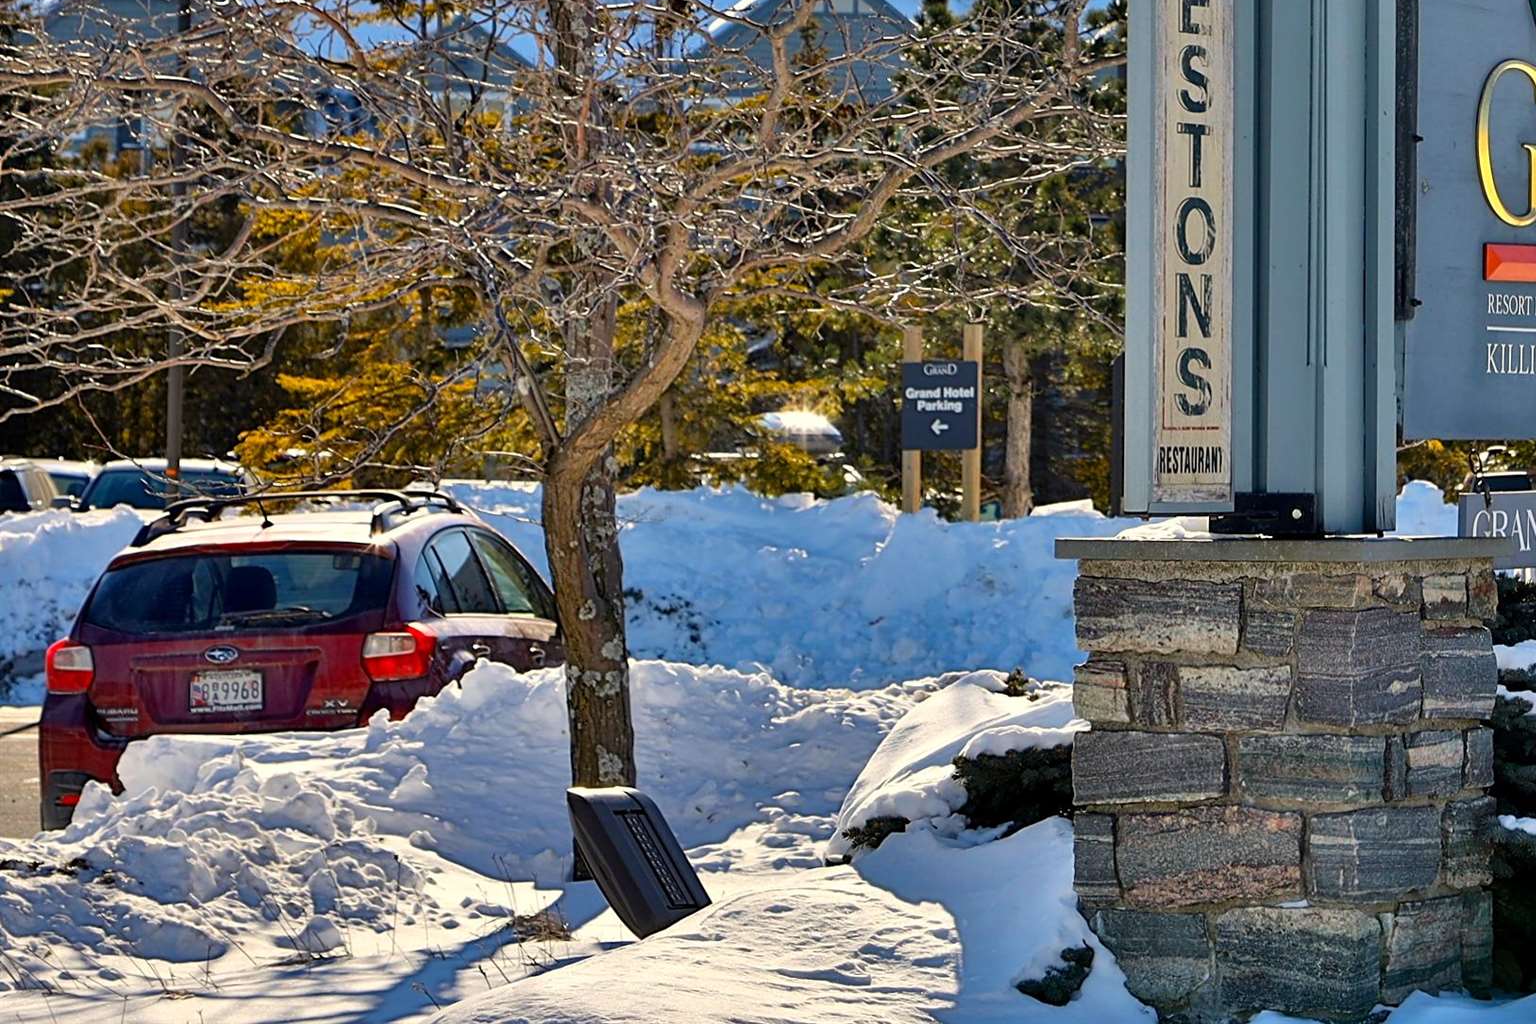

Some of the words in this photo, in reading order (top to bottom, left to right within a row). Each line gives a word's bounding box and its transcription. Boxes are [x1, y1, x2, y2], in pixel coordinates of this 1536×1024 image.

[1487, 293, 1533, 317] RESORT
[923, 362, 958, 376] GRAND
[905, 387, 941, 400] Grand
[943, 386, 975, 398] Hotel
[916, 399, 963, 413] Parking
[1159, 446, 1223, 474] RESTAURANT
